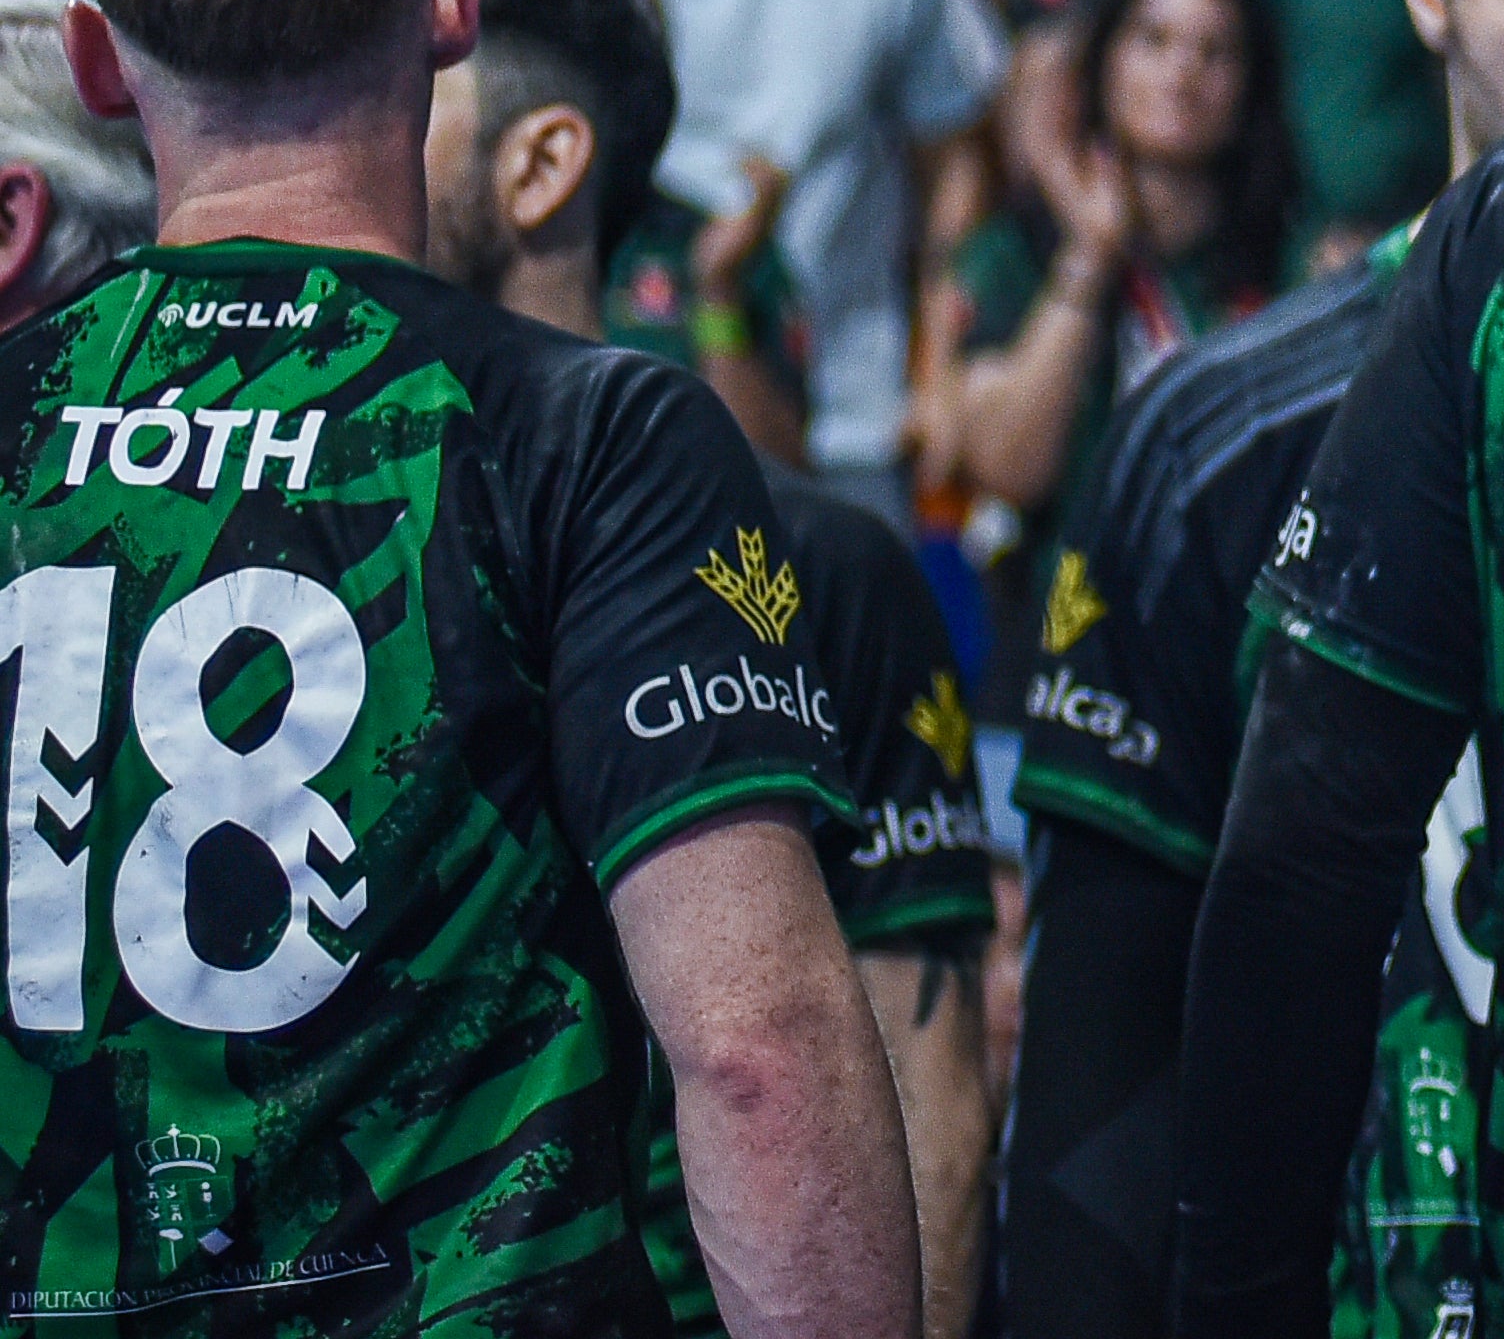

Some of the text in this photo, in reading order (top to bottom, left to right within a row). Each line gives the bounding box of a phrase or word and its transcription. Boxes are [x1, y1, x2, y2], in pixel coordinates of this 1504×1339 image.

[183, 301, 319, 331] UCLM
[61, 388, 327, 492] TÓTH
[624, 655, 838, 742] Globalc
[0, 565, 369, 1034] 18
[10, 1285, 137, 1309] DIPUTACIÓN
[268, 1258, 296, 1280] DE
